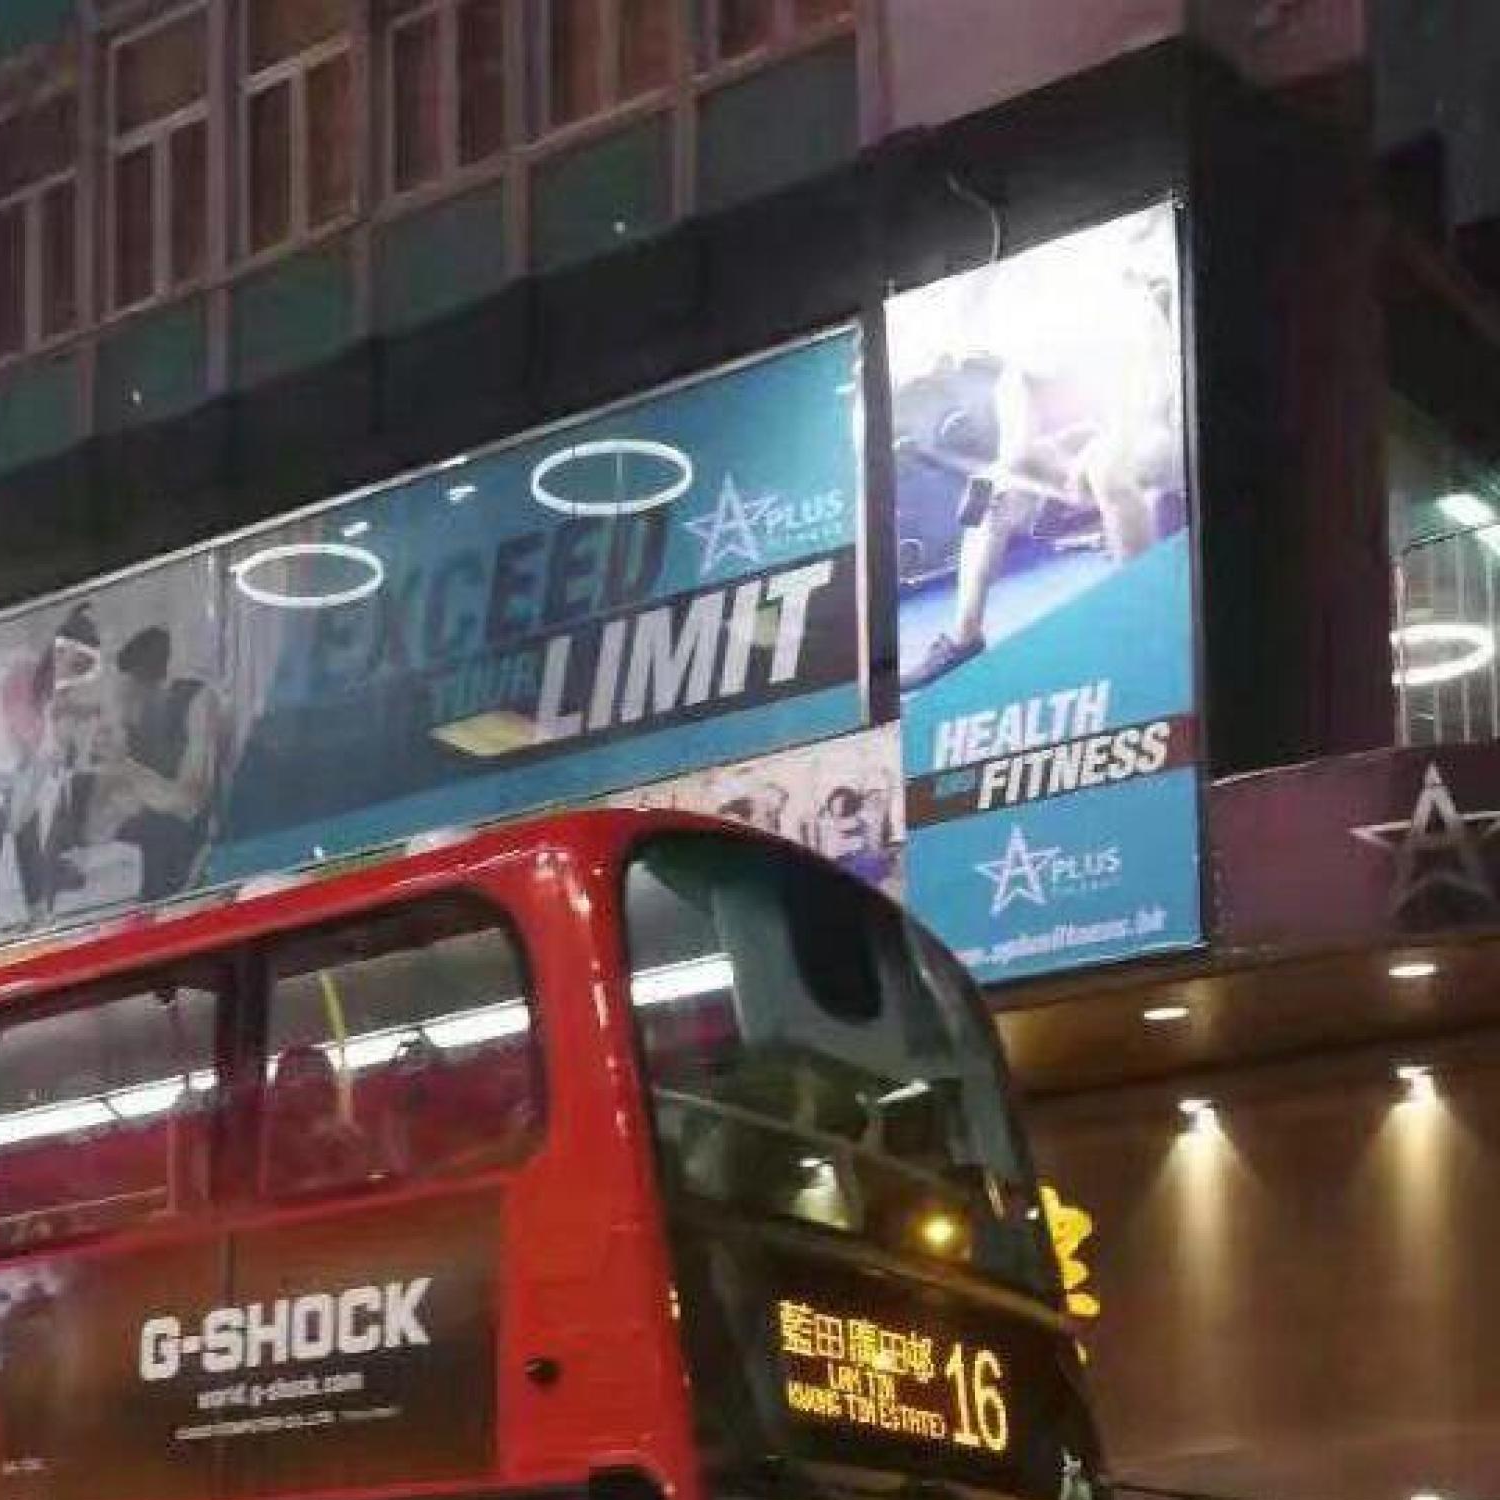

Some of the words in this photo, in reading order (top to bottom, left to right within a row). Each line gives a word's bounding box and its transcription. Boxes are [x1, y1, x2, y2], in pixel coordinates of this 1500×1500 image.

[530, 560, 833, 738] LIMIT
[933, 679, 1111, 771] HEALTH
[977, 721, 1170, 810] FITNESS
[1051, 846, 1122, 881] PLUS
[139, 1276, 433, 1381] G-SHOCK
[946, 1342, 1008, 1451] 16
